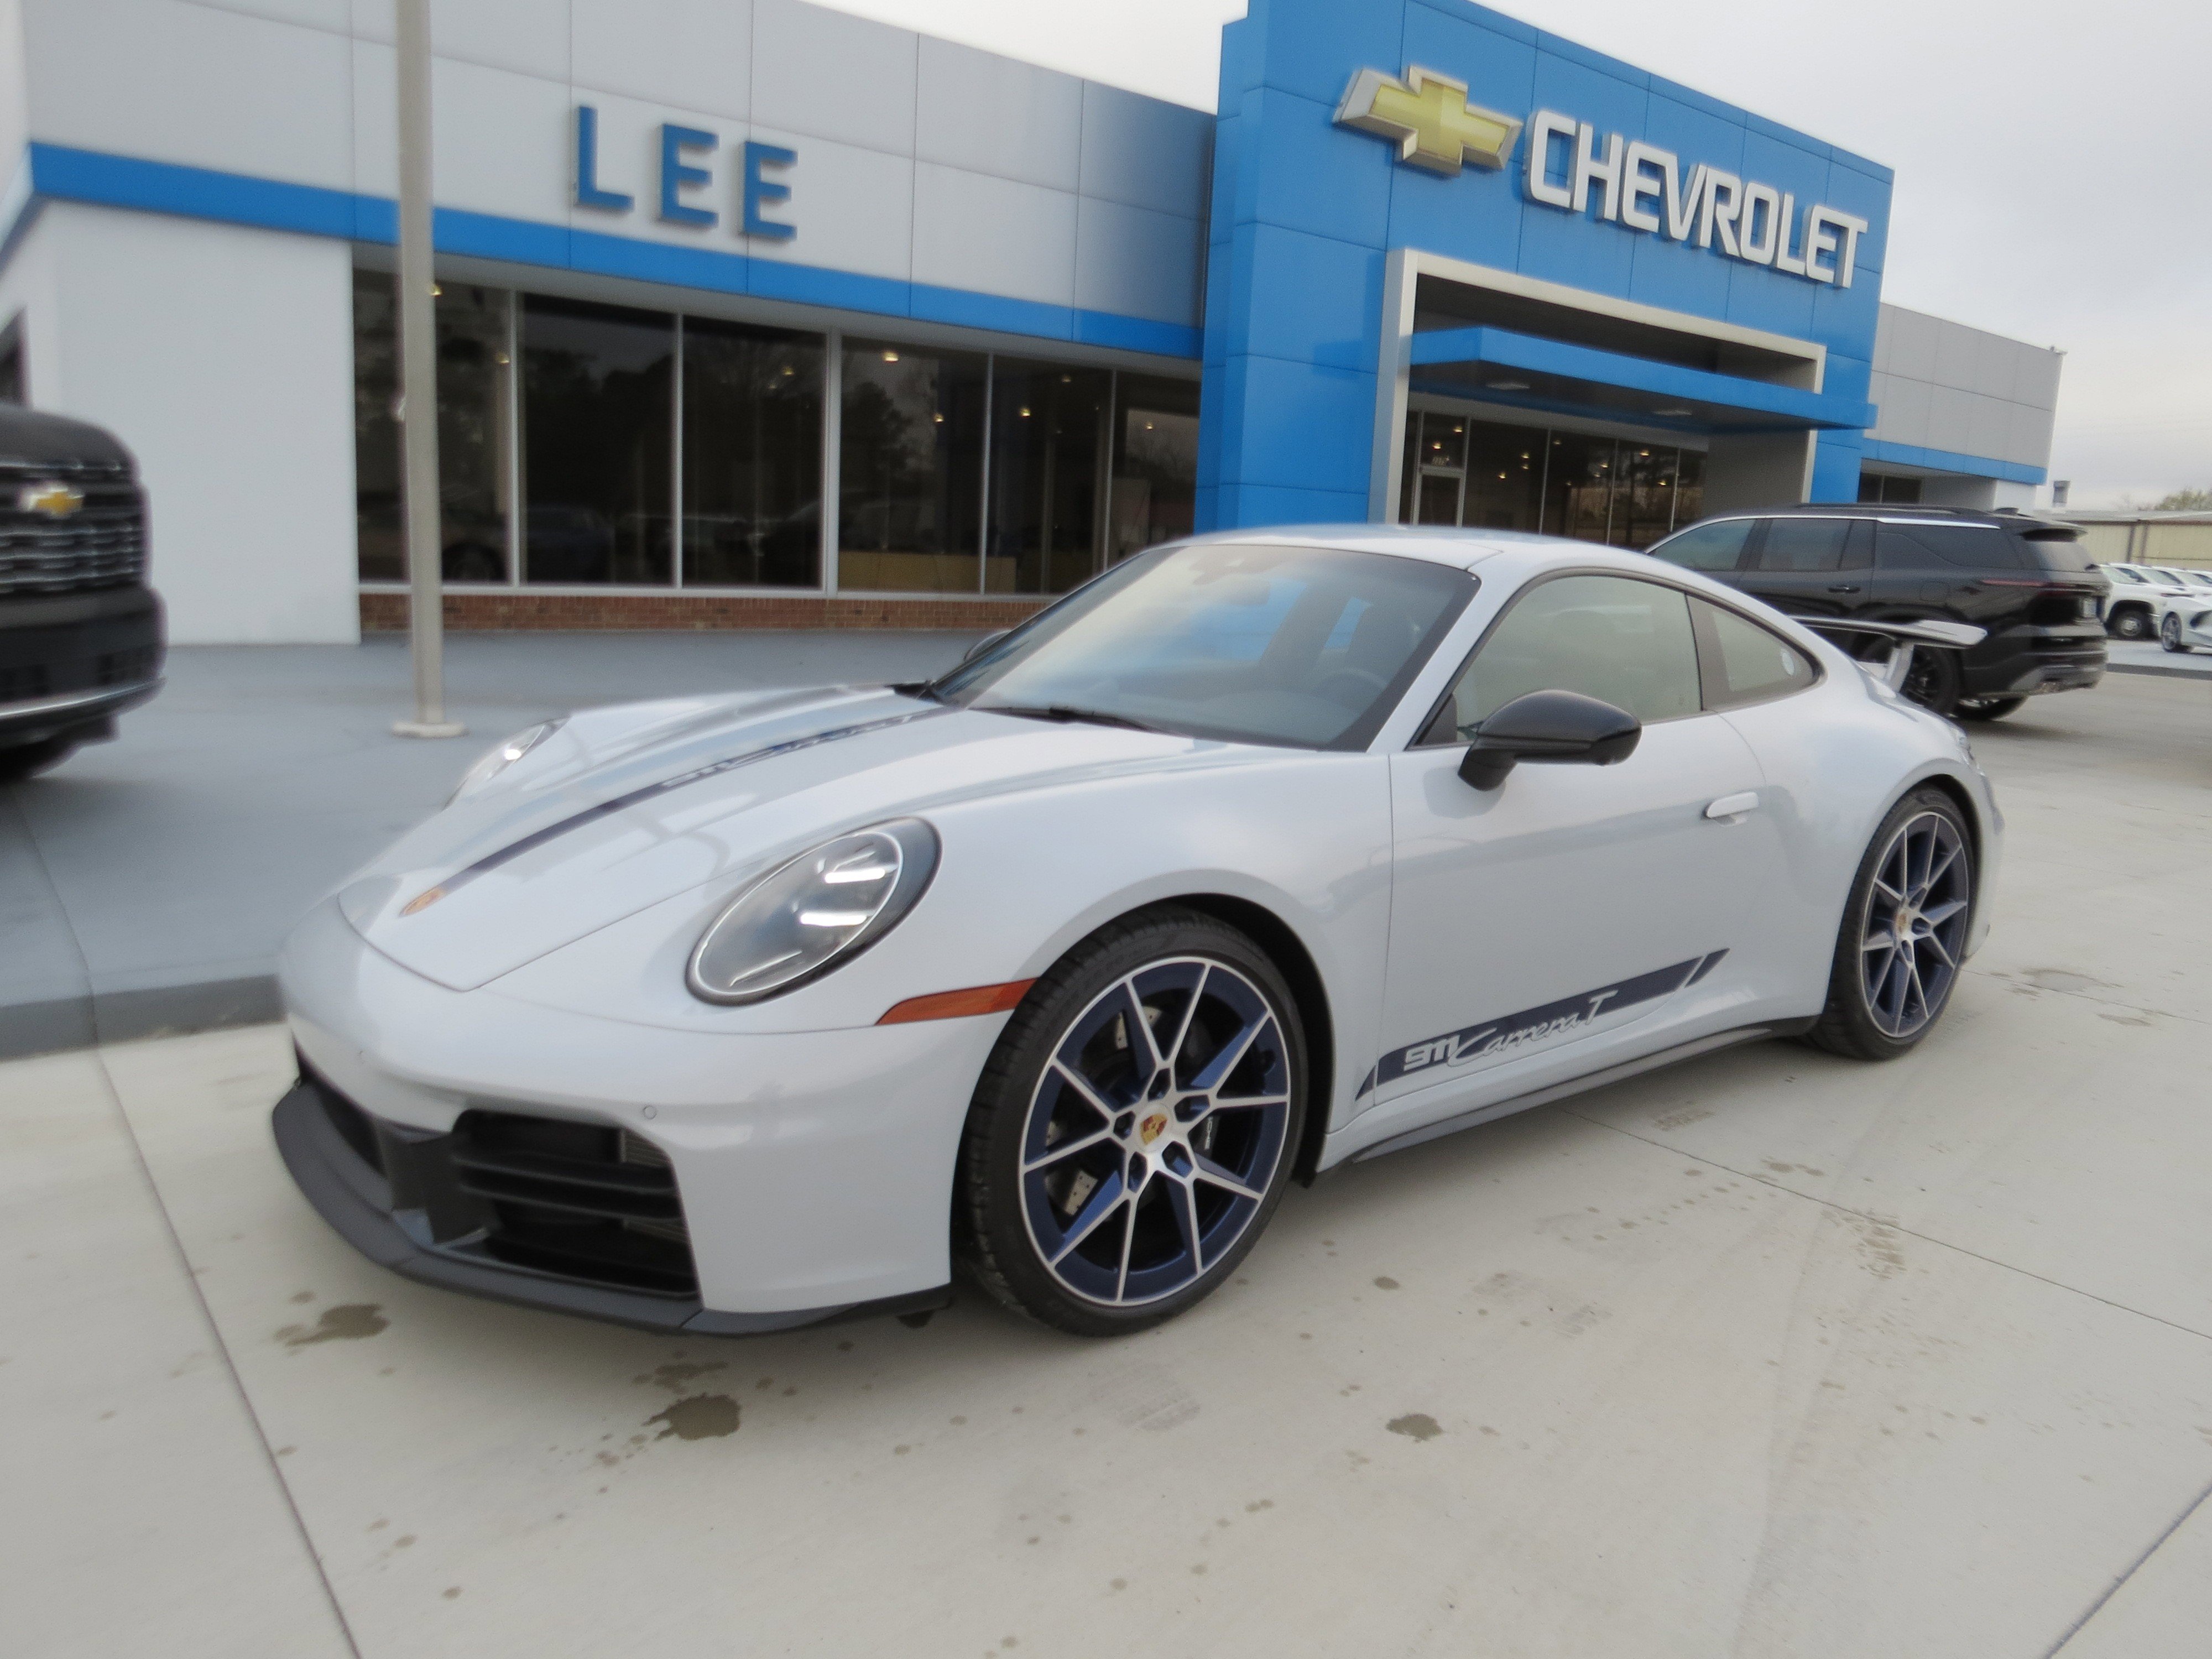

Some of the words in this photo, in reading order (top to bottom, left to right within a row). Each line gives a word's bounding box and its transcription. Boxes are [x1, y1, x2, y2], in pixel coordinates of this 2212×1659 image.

[576, 105, 799, 242] LEE
[1524, 109, 1869, 289] CHEVROLET
[1403, 1034, 1460, 1072] 911
[1447, 1011, 1582, 1067] Carrera
[1586, 989, 1619, 1025] T
